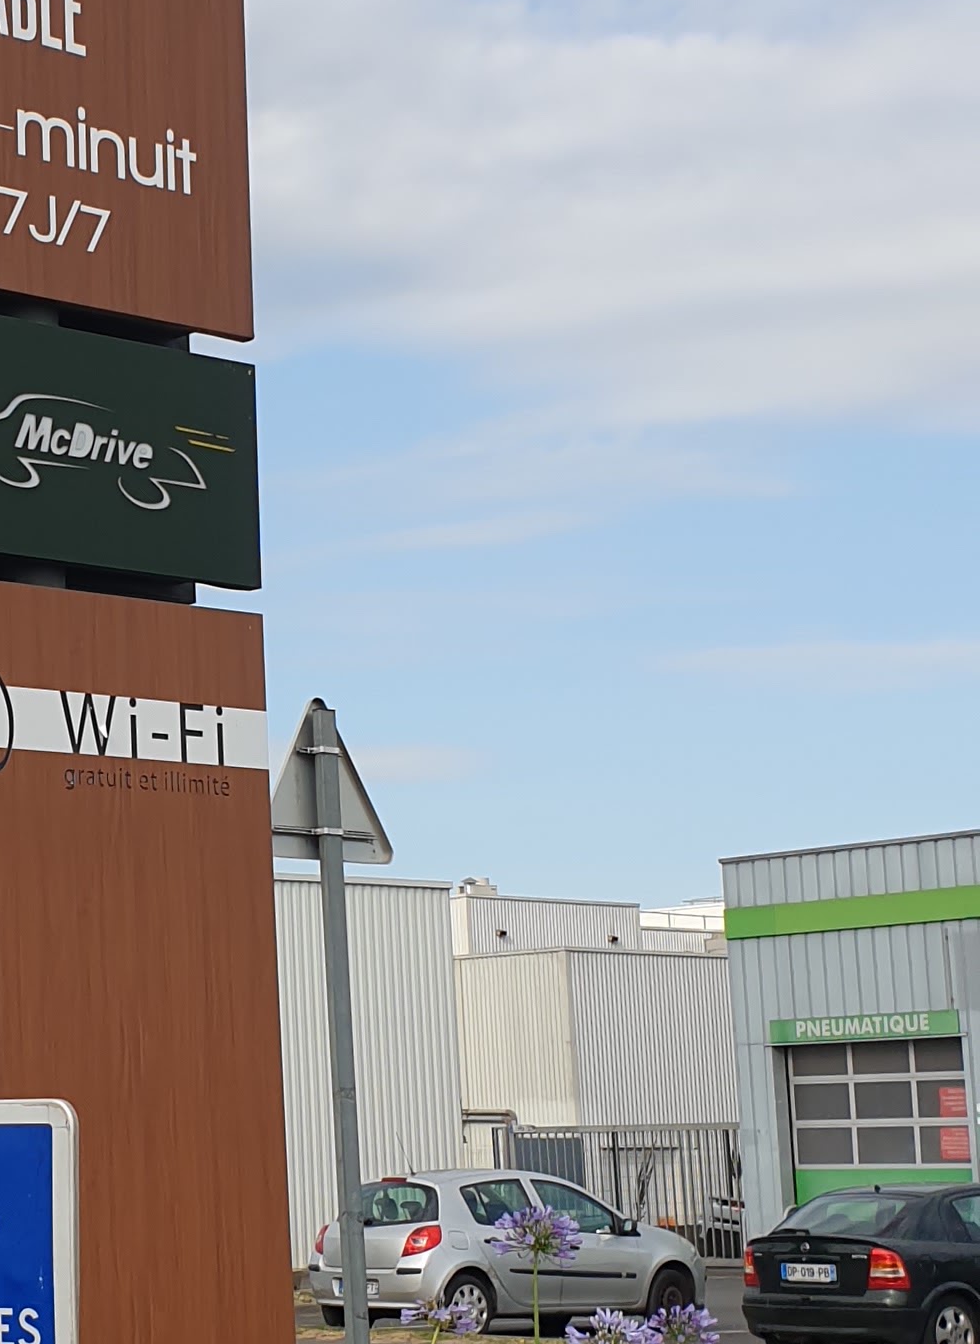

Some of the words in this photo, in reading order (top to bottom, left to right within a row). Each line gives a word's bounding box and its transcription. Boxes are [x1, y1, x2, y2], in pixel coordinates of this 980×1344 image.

[14, 412, 154, 470] McDrive
[59, 689, 225, 767] Wi-Fi
[64, 767, 132, 790] gratuit
[139, 770, 158, 792] et
[164, 772, 231, 796] illimité
[795, 1013, 930, 1038] PNEUMATIQUE
